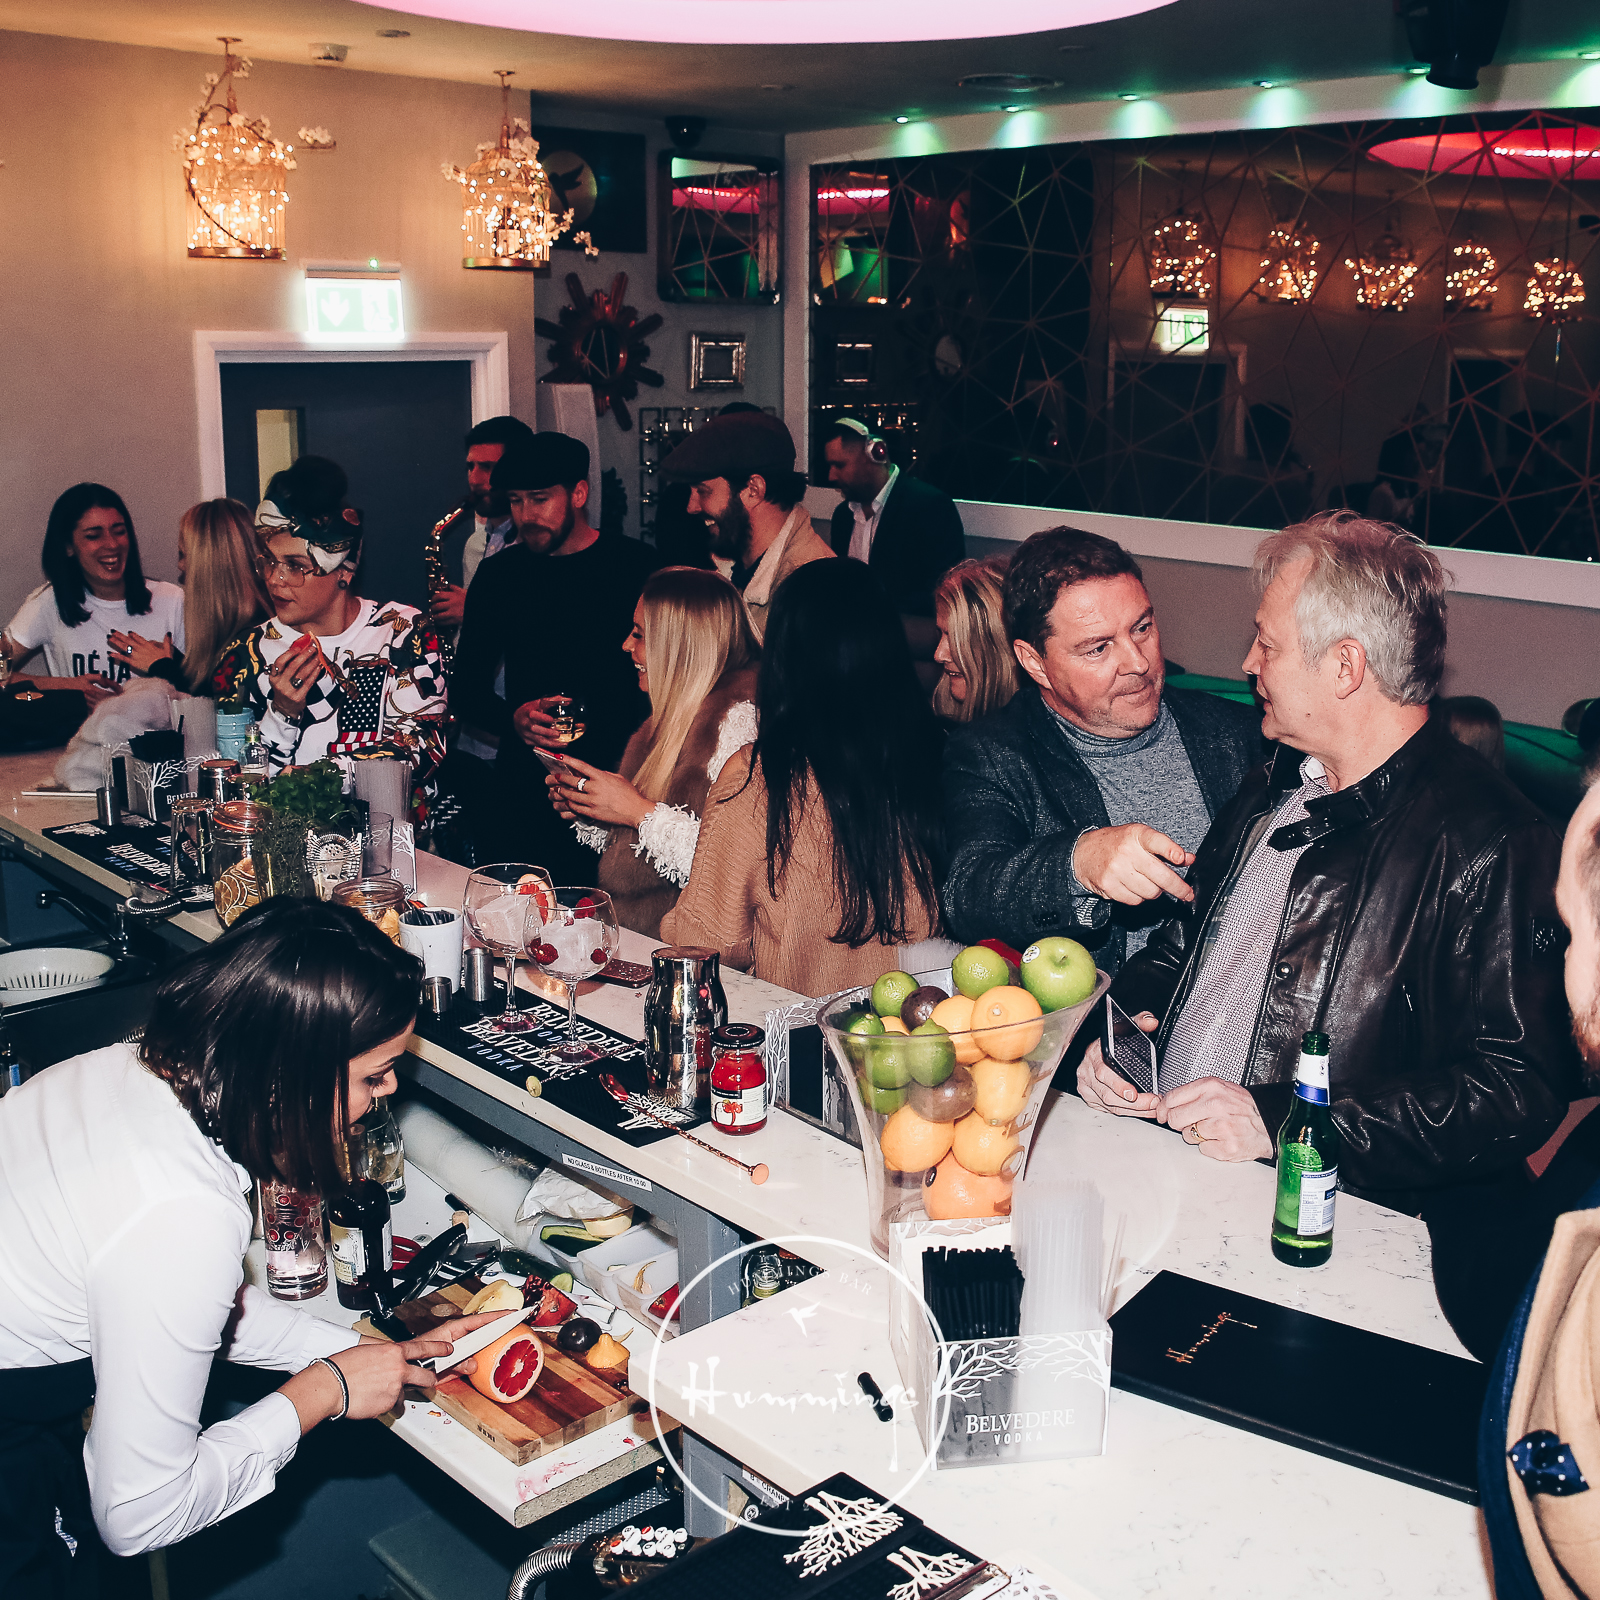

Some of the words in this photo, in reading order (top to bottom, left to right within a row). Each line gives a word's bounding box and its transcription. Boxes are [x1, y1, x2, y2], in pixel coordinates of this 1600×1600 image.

[467, 1042, 524, 1072] VODKA
[567, 1157, 575, 1165] NO
[575, 1160, 590, 1170] GLASS
[595, 1167, 617, 1178] BOTTLES
[617, 1173, 633, 1183] AFTER
[965, 1408, 1076, 1434] BELVEDERE
[993, 1430, 1043, 1446] VODKA
